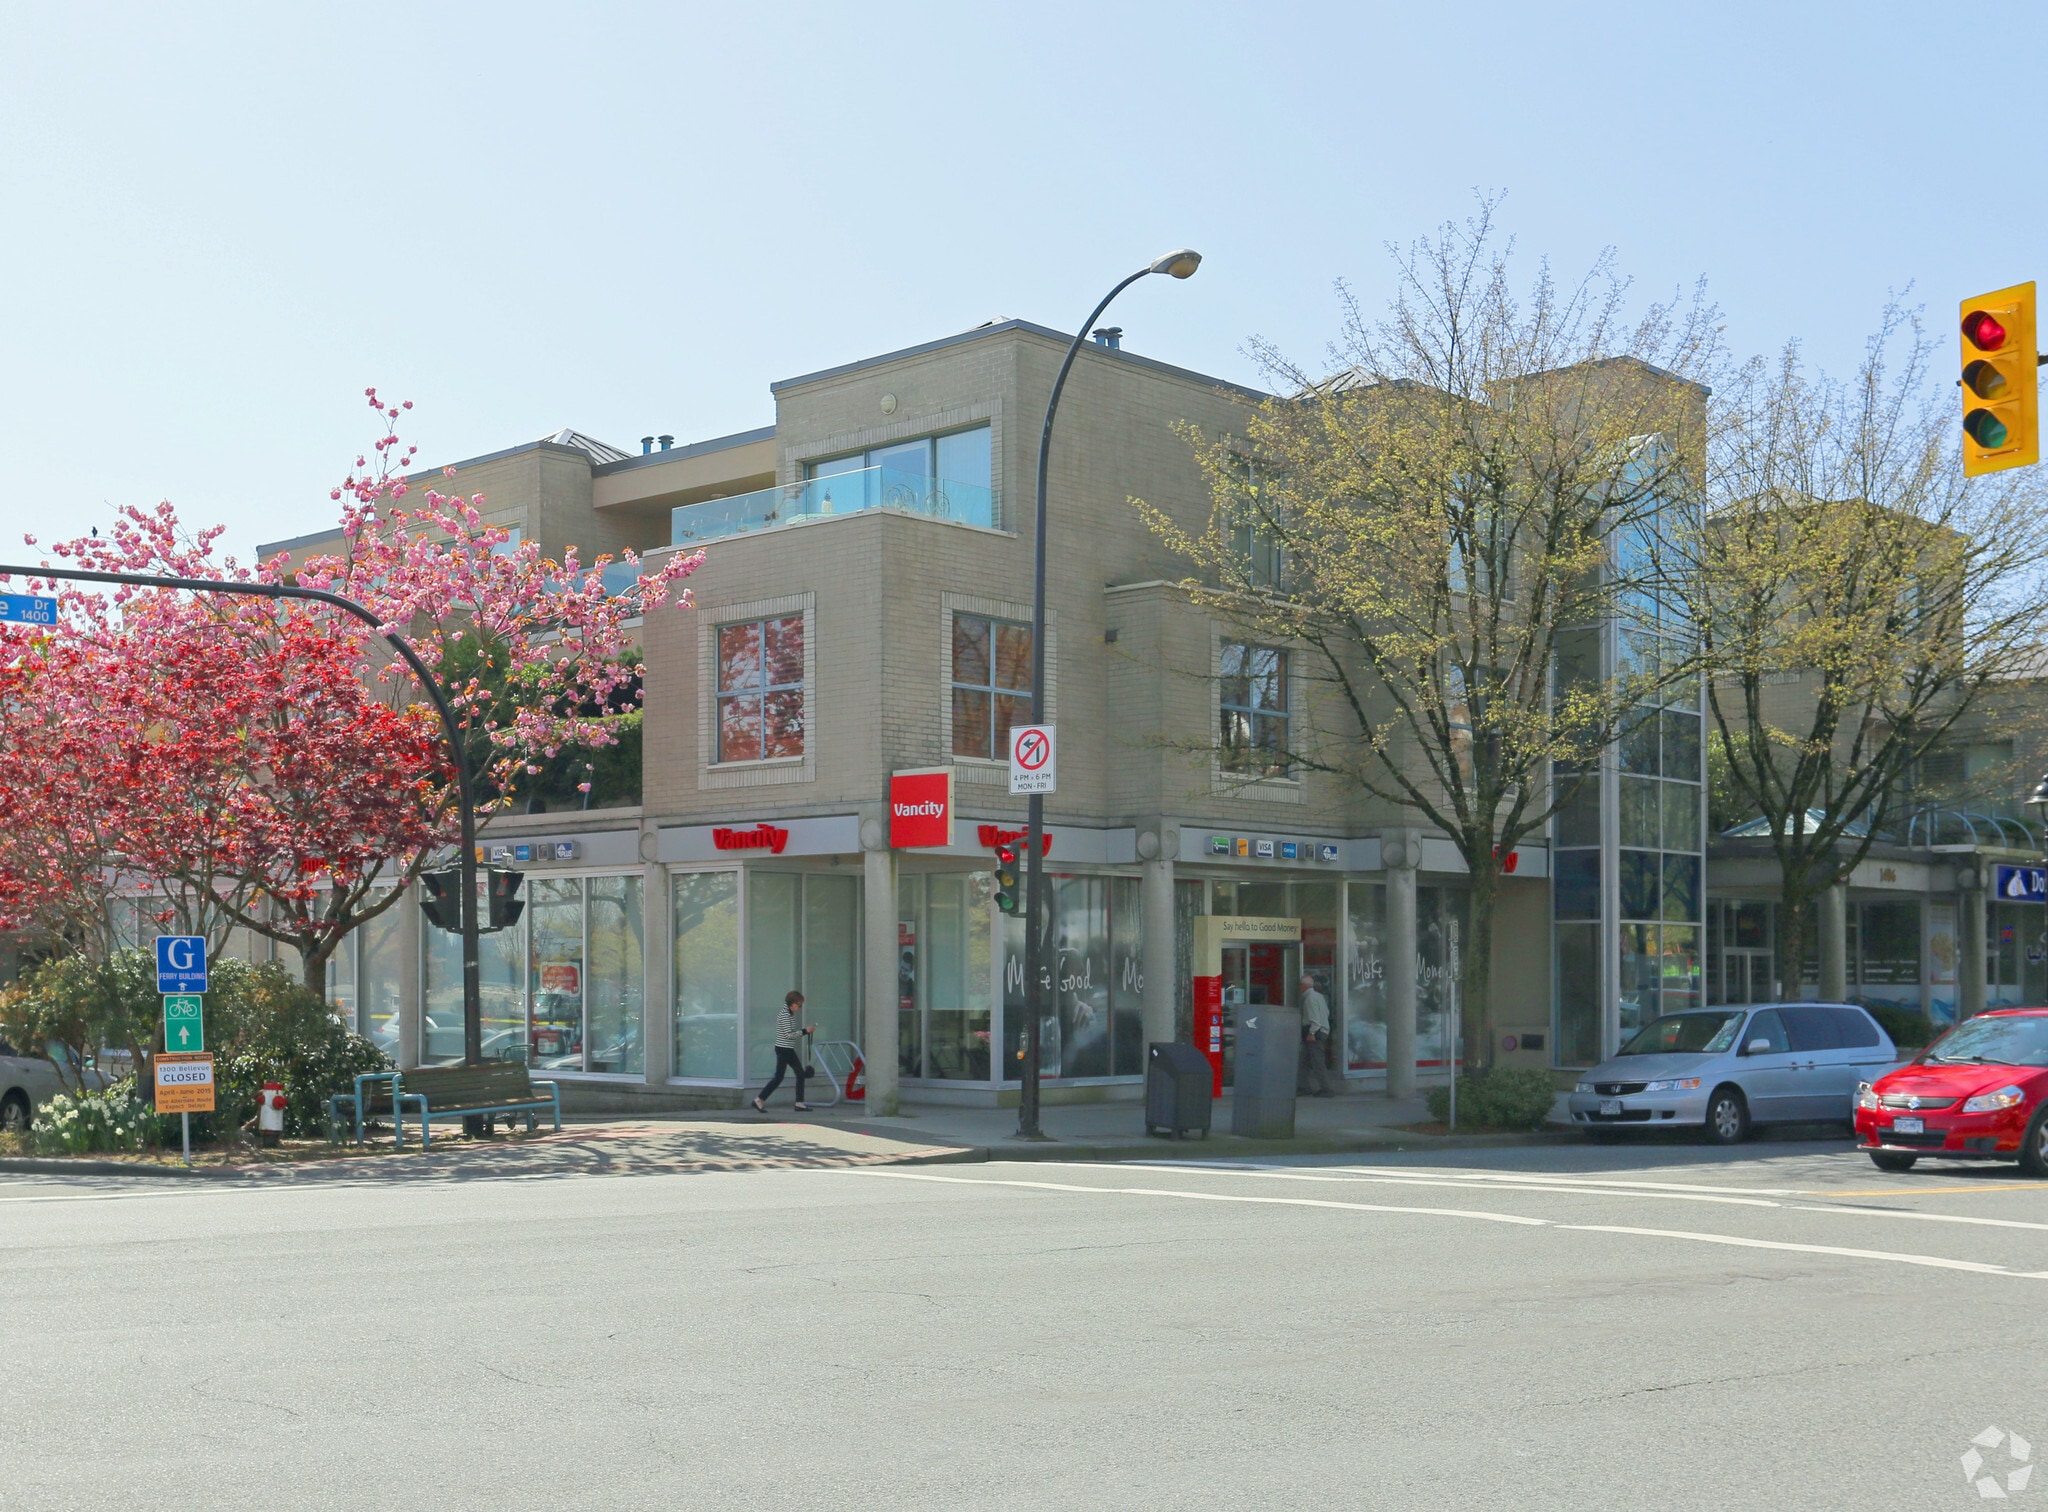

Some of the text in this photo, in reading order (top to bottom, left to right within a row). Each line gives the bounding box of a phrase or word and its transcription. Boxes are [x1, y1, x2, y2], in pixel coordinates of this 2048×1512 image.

[34, 599, 49, 610] Dr
[21, 610, 50, 622] 1400
[894, 800, 945, 819] Vancity
[712, 823, 789, 854] Vancity
[1259, 842, 1272, 851] VISA
[2031, 871, 2046, 893] Do
[1223, 920, 1297, 934] Say hello to Good Money
[168, 938, 195, 970] G
[1352, 953, 1383, 984] Make
[160, 972, 206, 980] FERRY BUILDING
[163, 1072, 206, 1082] CLOSED
